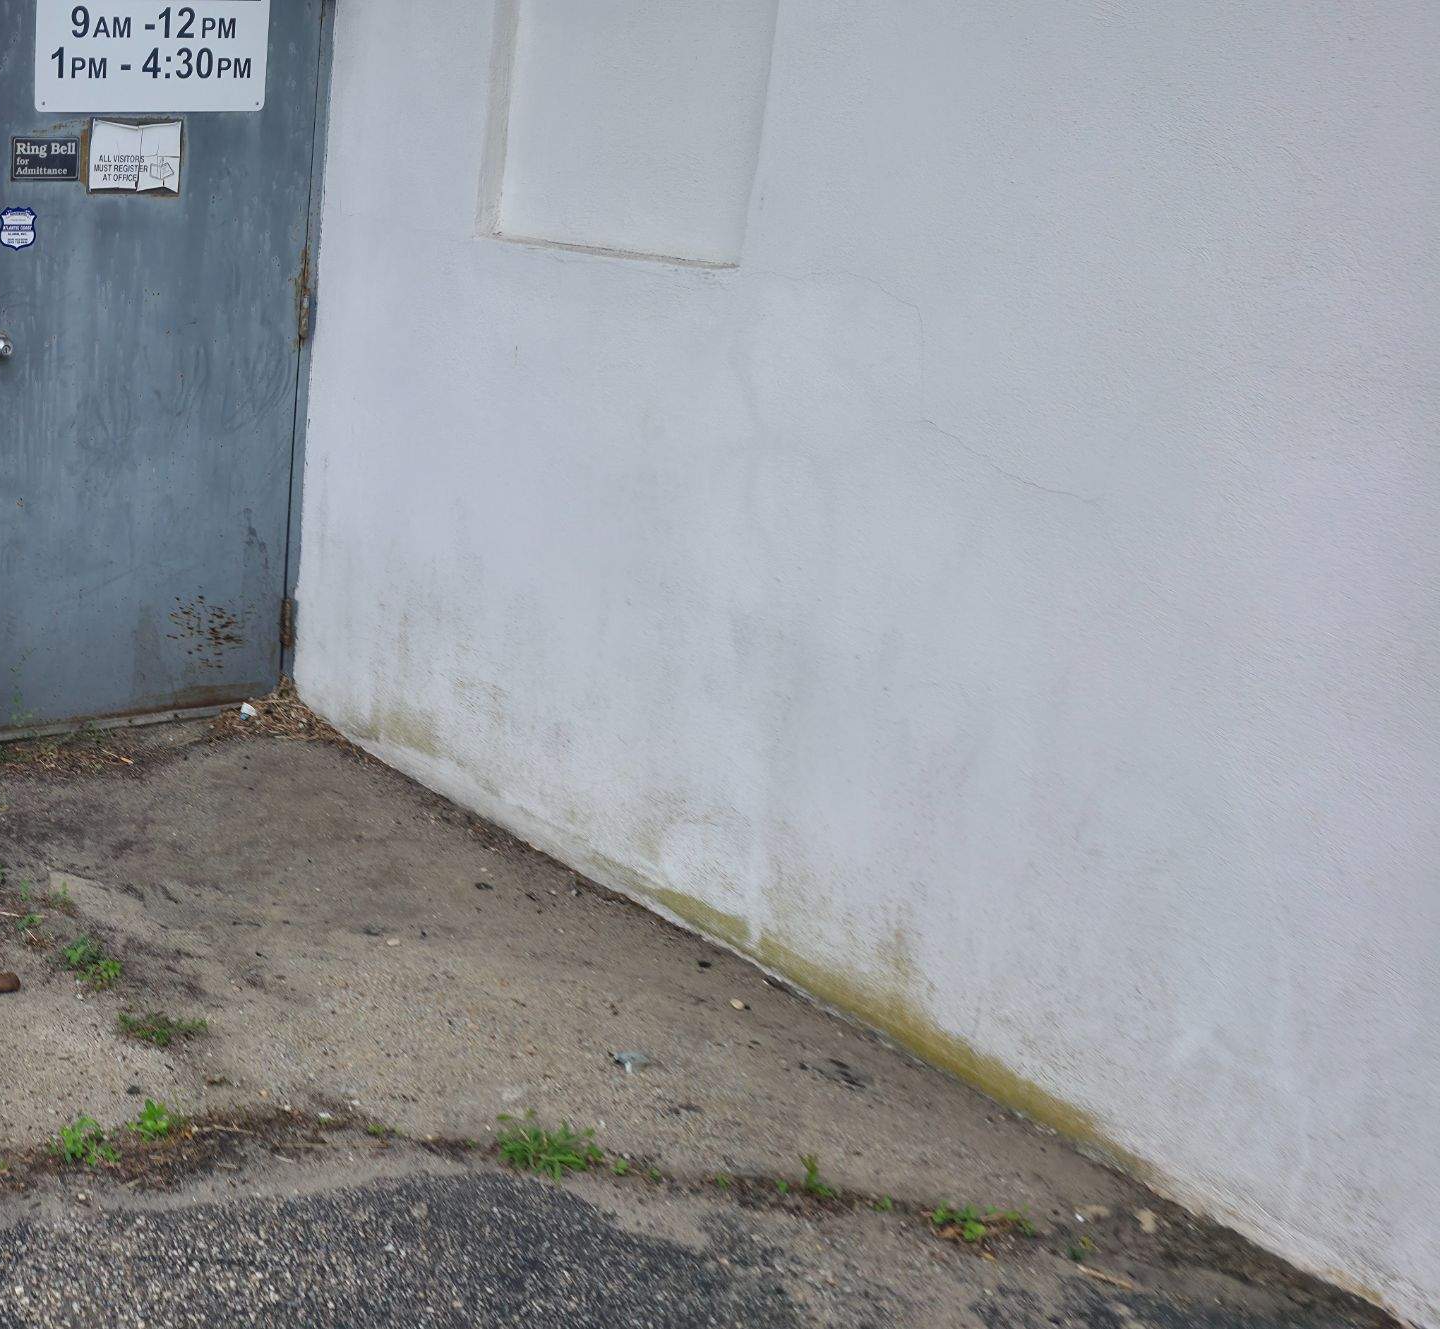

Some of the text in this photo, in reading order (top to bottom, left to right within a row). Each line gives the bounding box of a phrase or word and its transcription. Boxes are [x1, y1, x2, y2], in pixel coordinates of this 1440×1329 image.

[16, 142, 76, 158] Ring Bell
[16, 157, 30, 165] for
[99, 154, 145, 163] ALL VISITORS
[16, 166, 68, 175] Admittance
[93, 163, 149, 173] MUST REGISTER
[102, 173, 138, 182] AT OFFICE
